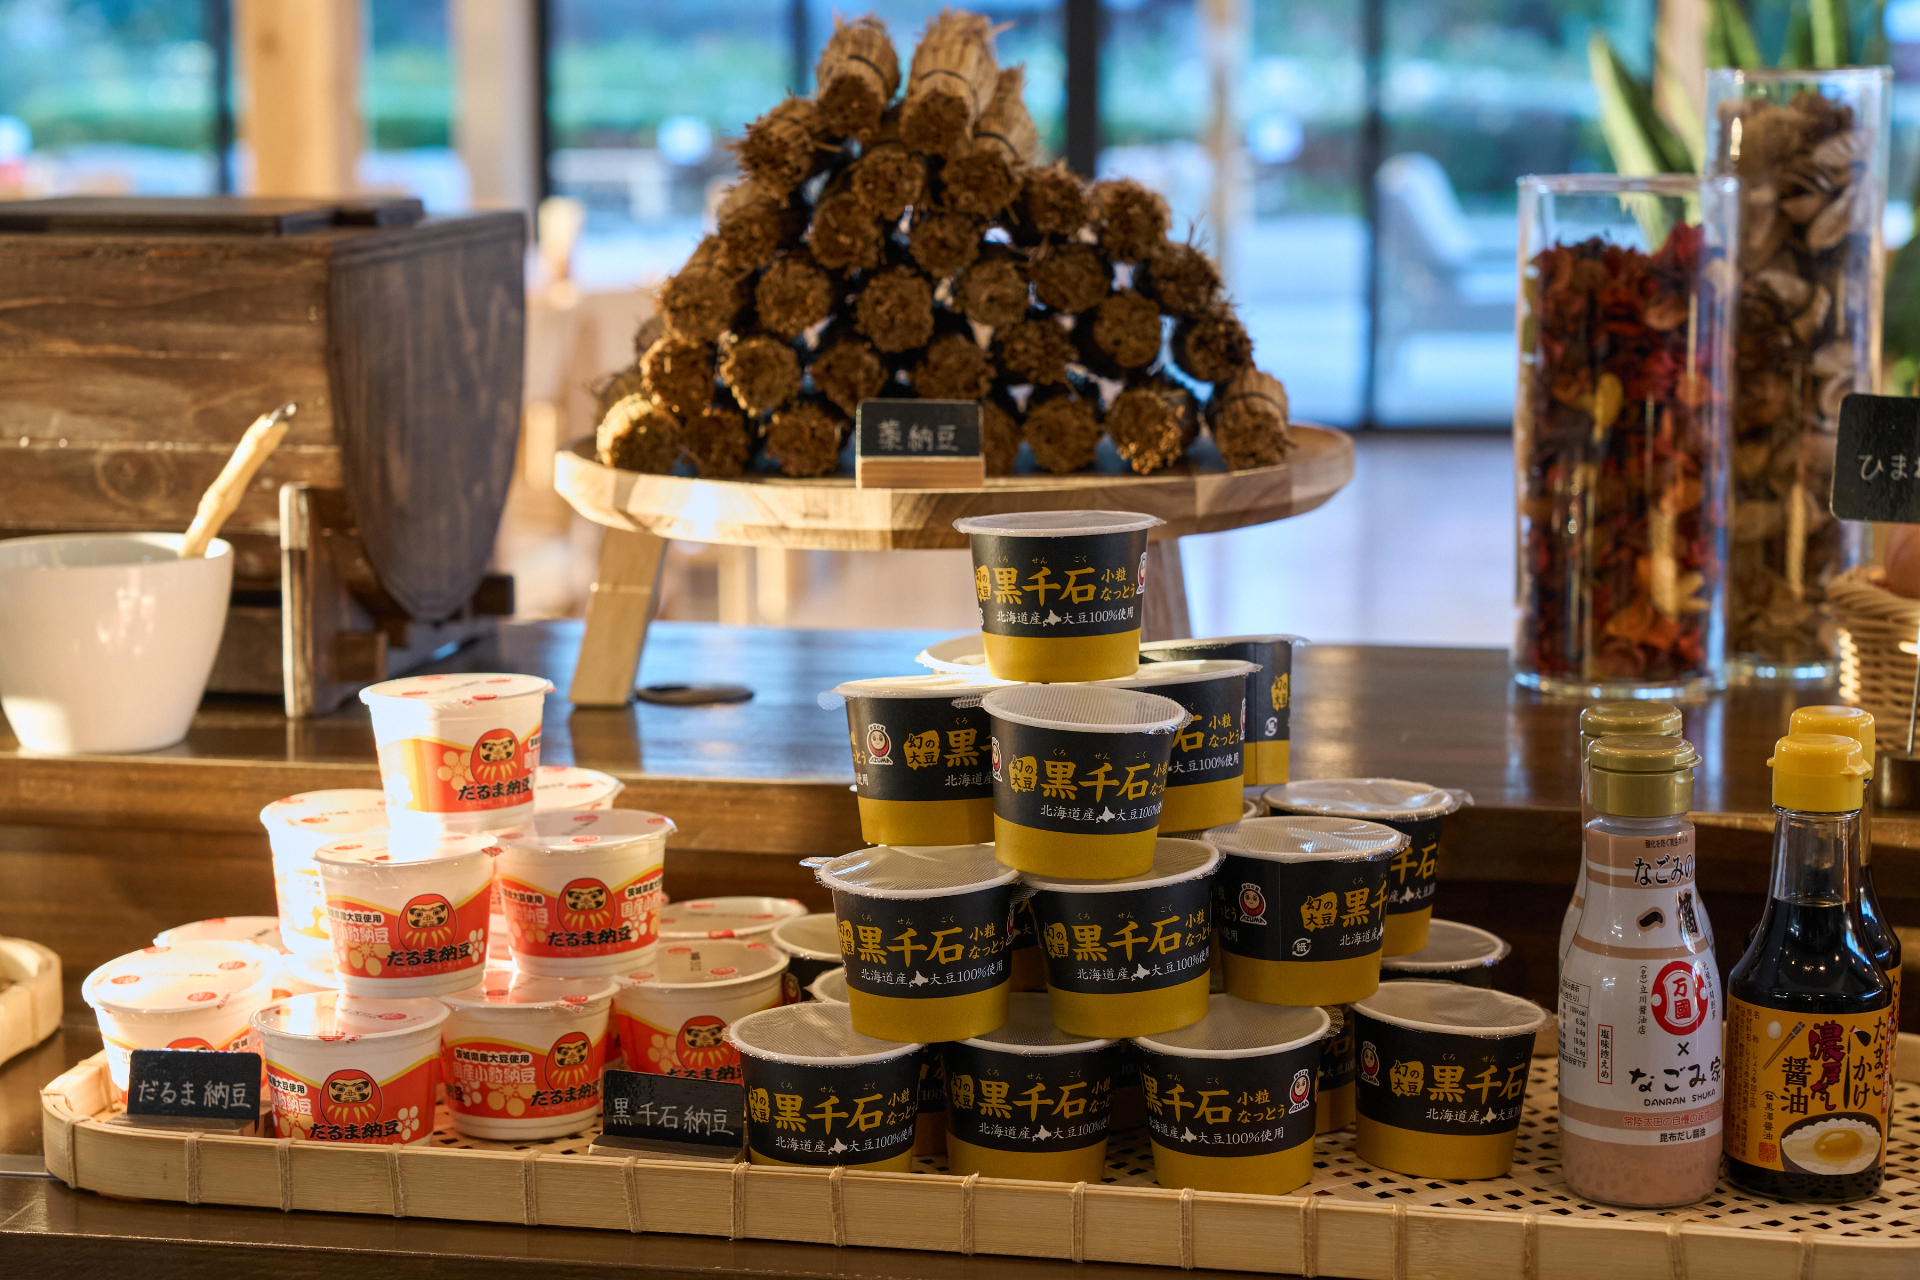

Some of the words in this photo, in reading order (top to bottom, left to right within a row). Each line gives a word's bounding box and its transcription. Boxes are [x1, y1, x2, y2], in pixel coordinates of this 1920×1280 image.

[1032, 557, 1047, 565] せん
[1073, 555, 1087, 563] ごく
[1101, 567, 1126, 583] 小粒
[992, 566, 1097, 607] 黒千石
[1100, 583, 1135, 601] なっとう
[996, 610, 1041, 625] 北海道産
[1063, 606, 1134, 625] 大豆100%使用
[1209, 713, 1231, 730] 小粒
[908, 735, 935, 750] 幻の
[1209, 729, 1239, 748] なっとう
[909, 751, 938, 764] 大豆
[1053, 749, 1066, 757] くろ
[1135, 750, 1147, 759] ごく
[1173, 752, 1239, 773] 大豆100%使用
[1012, 757, 1033, 774] 幻の
[457, 777, 531, 801] だるま納豆
[1012, 774, 1034, 790] 大豆
[1040, 759, 1151, 803] 黒千石
[1040, 804, 1095, 821] 北海道産
[1634, 852, 1694, 886] なごみの
[1077, 912, 1091, 920] くろ
[1161, 904, 1172, 912] ごく
[1306, 896, 1334, 911] 幻の
[941, 915, 954, 923] ごく
[1185, 909, 1205, 928] 小粒
[1306, 914, 1334, 926] 大豆
[548, 926, 632, 947] だるま納豆
[969, 922, 996, 941] 小粒
[1071, 915, 1182, 962] 黒千石
[1340, 928, 1379, 947] 北海道産
[386, 942, 473, 967] だるま納豆
[856, 924, 965, 968] 黒千石
[969, 937, 1005, 960] なっとう
[861, 968, 908, 985] 北海道産
[929, 959, 1003, 985] 大豆100%使用
[1077, 967, 1130, 981] 北海道産
[1808, 1020, 1846, 1111] 濃厚だし
[1873, 1016, 1887, 1097] たまご
[453, 1062, 536, 1084] 国産小粒納豆
[987, 1068, 999, 1076] くろ
[1027, 1072, 1043, 1080] せん
[1394, 1063, 1420, 1079] 幻の
[780, 1082, 793, 1090] くろ
[820, 1085, 835, 1093] せん
[1206, 1077, 1219, 1085] ごく
[1393, 1078, 1420, 1094] 大豆
[1427, 1062, 1526, 1105] 黒千石
[1780, 1056, 1812, 1115] 醤油
[1853, 1056, 1873, 1110] かけ
[138, 1080, 251, 1110] だるま納豆
[887, 1088, 910, 1107] 小粒
[977, 1079, 1088, 1122] 黒千石
[1143, 1072, 1232, 1125] 黒千石
[1237, 1088, 1271, 1105] 小粒
[1644, 1097, 1686, 1106] DANRAN
[1692, 1088, 1716, 1102] SHUKA
[612, 1097, 735, 1137] 黒千石納豆
[773, 1092, 884, 1135] 黒千石
[1237, 1104, 1285, 1124] なっとう
[1426, 1107, 1479, 1123] 北海道産
[309, 1119, 400, 1141] だるま納豆
[979, 1122, 1031, 1139] 北海道産
[1198, 1126, 1284, 1145] 大豆100%使用
[1660, 1127, 1706, 1143] 昆布だし醤油
[775, 1136, 827, 1153] 北海道産
